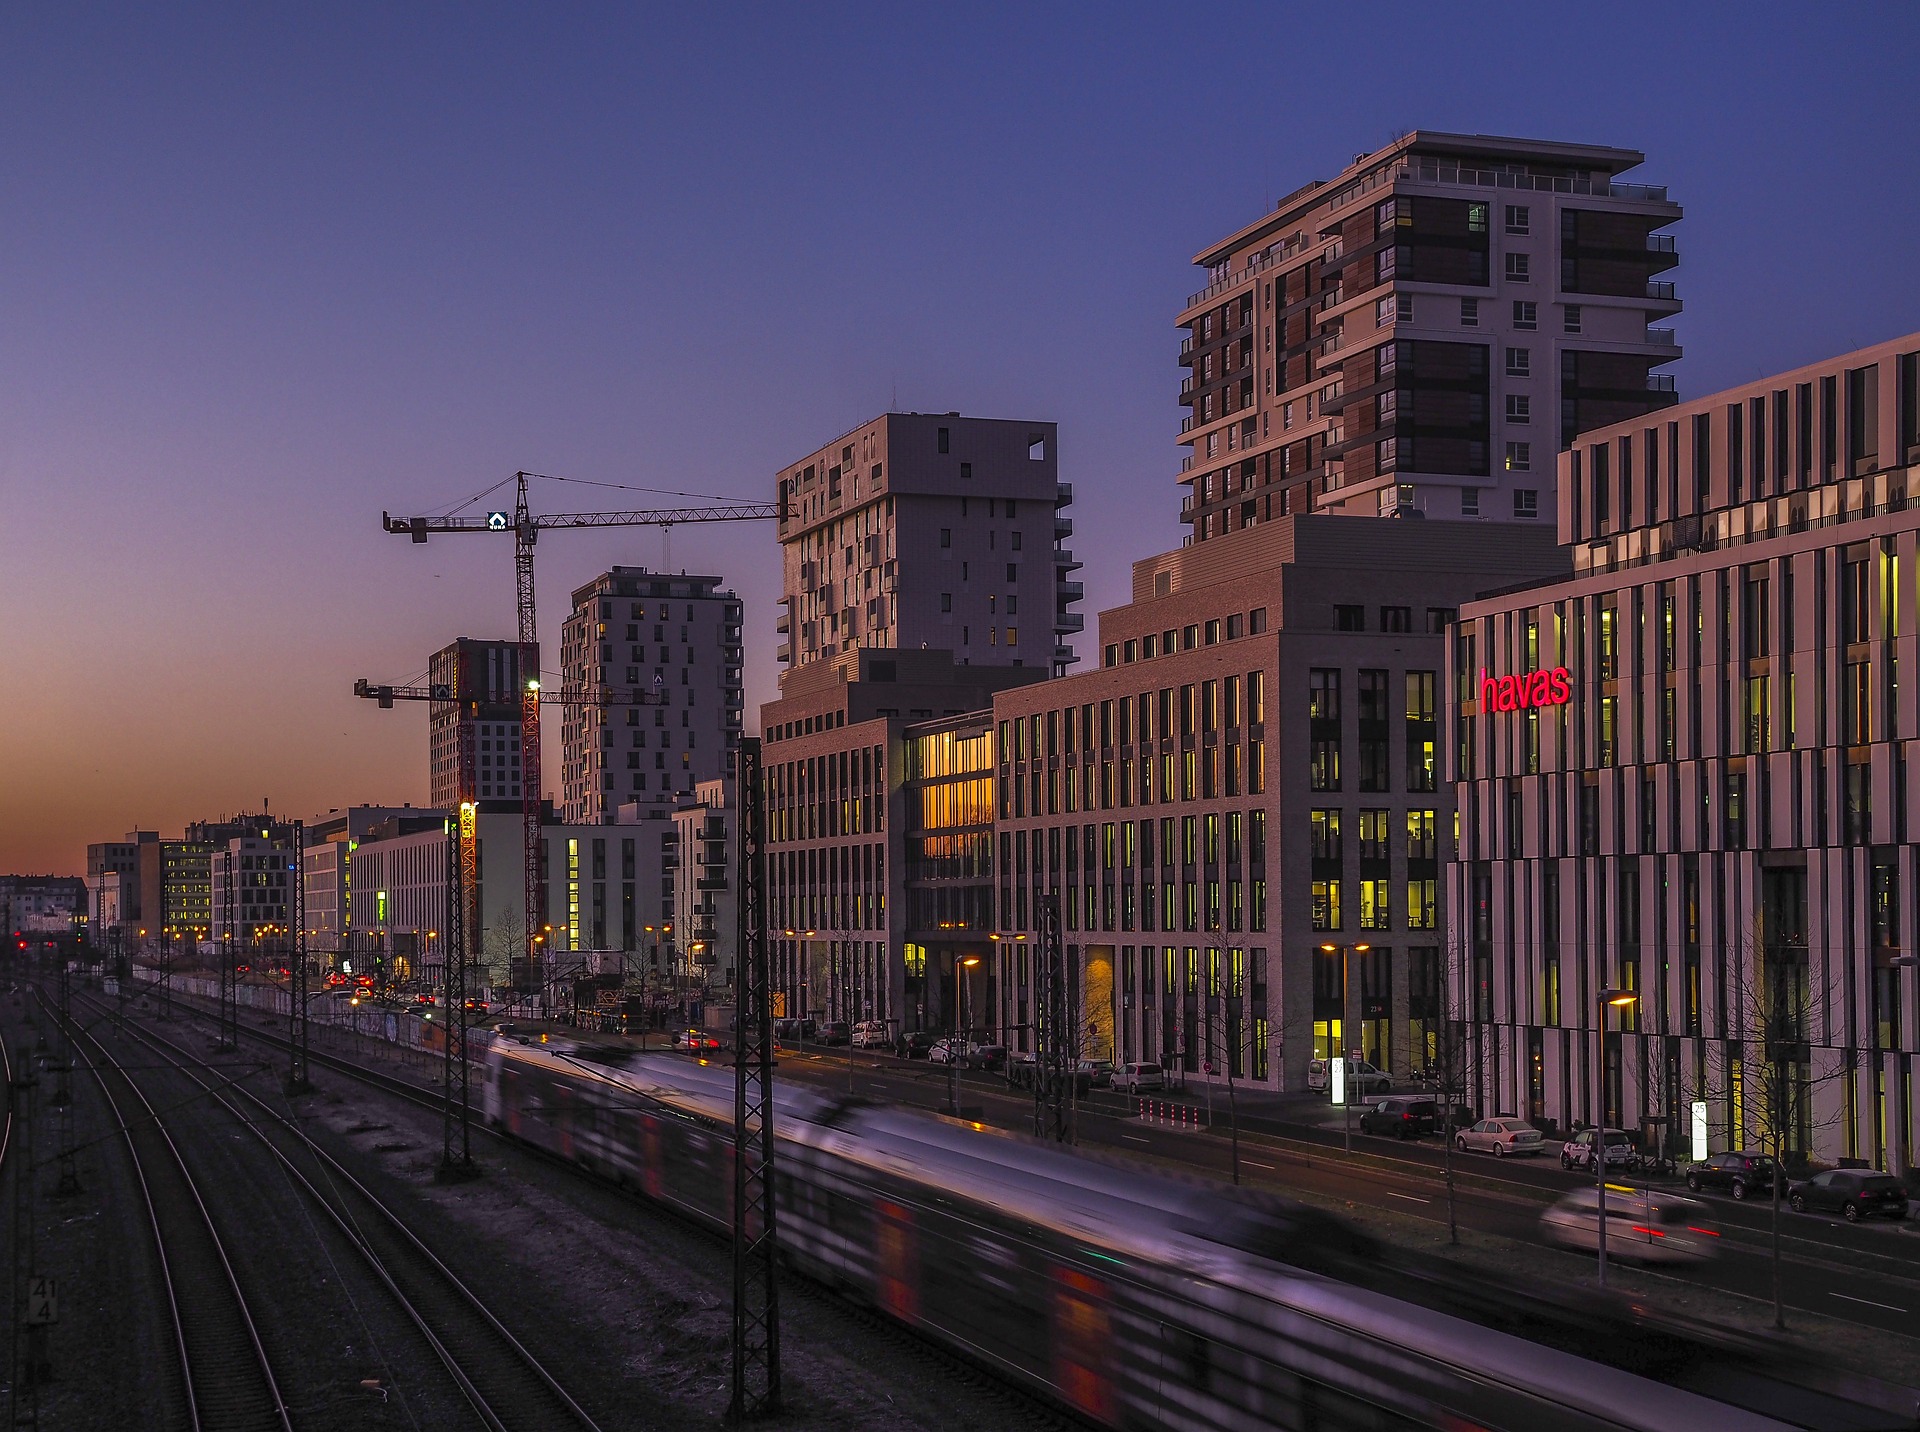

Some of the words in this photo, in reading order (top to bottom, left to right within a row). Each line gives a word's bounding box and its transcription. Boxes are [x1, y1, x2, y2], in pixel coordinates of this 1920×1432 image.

[1481, 666, 1570, 714] havas
[1695, 1104, 1705, 1113] 25
[32, 1280, 56, 1298] 41
[38, 1301, 51, 1320] 4
